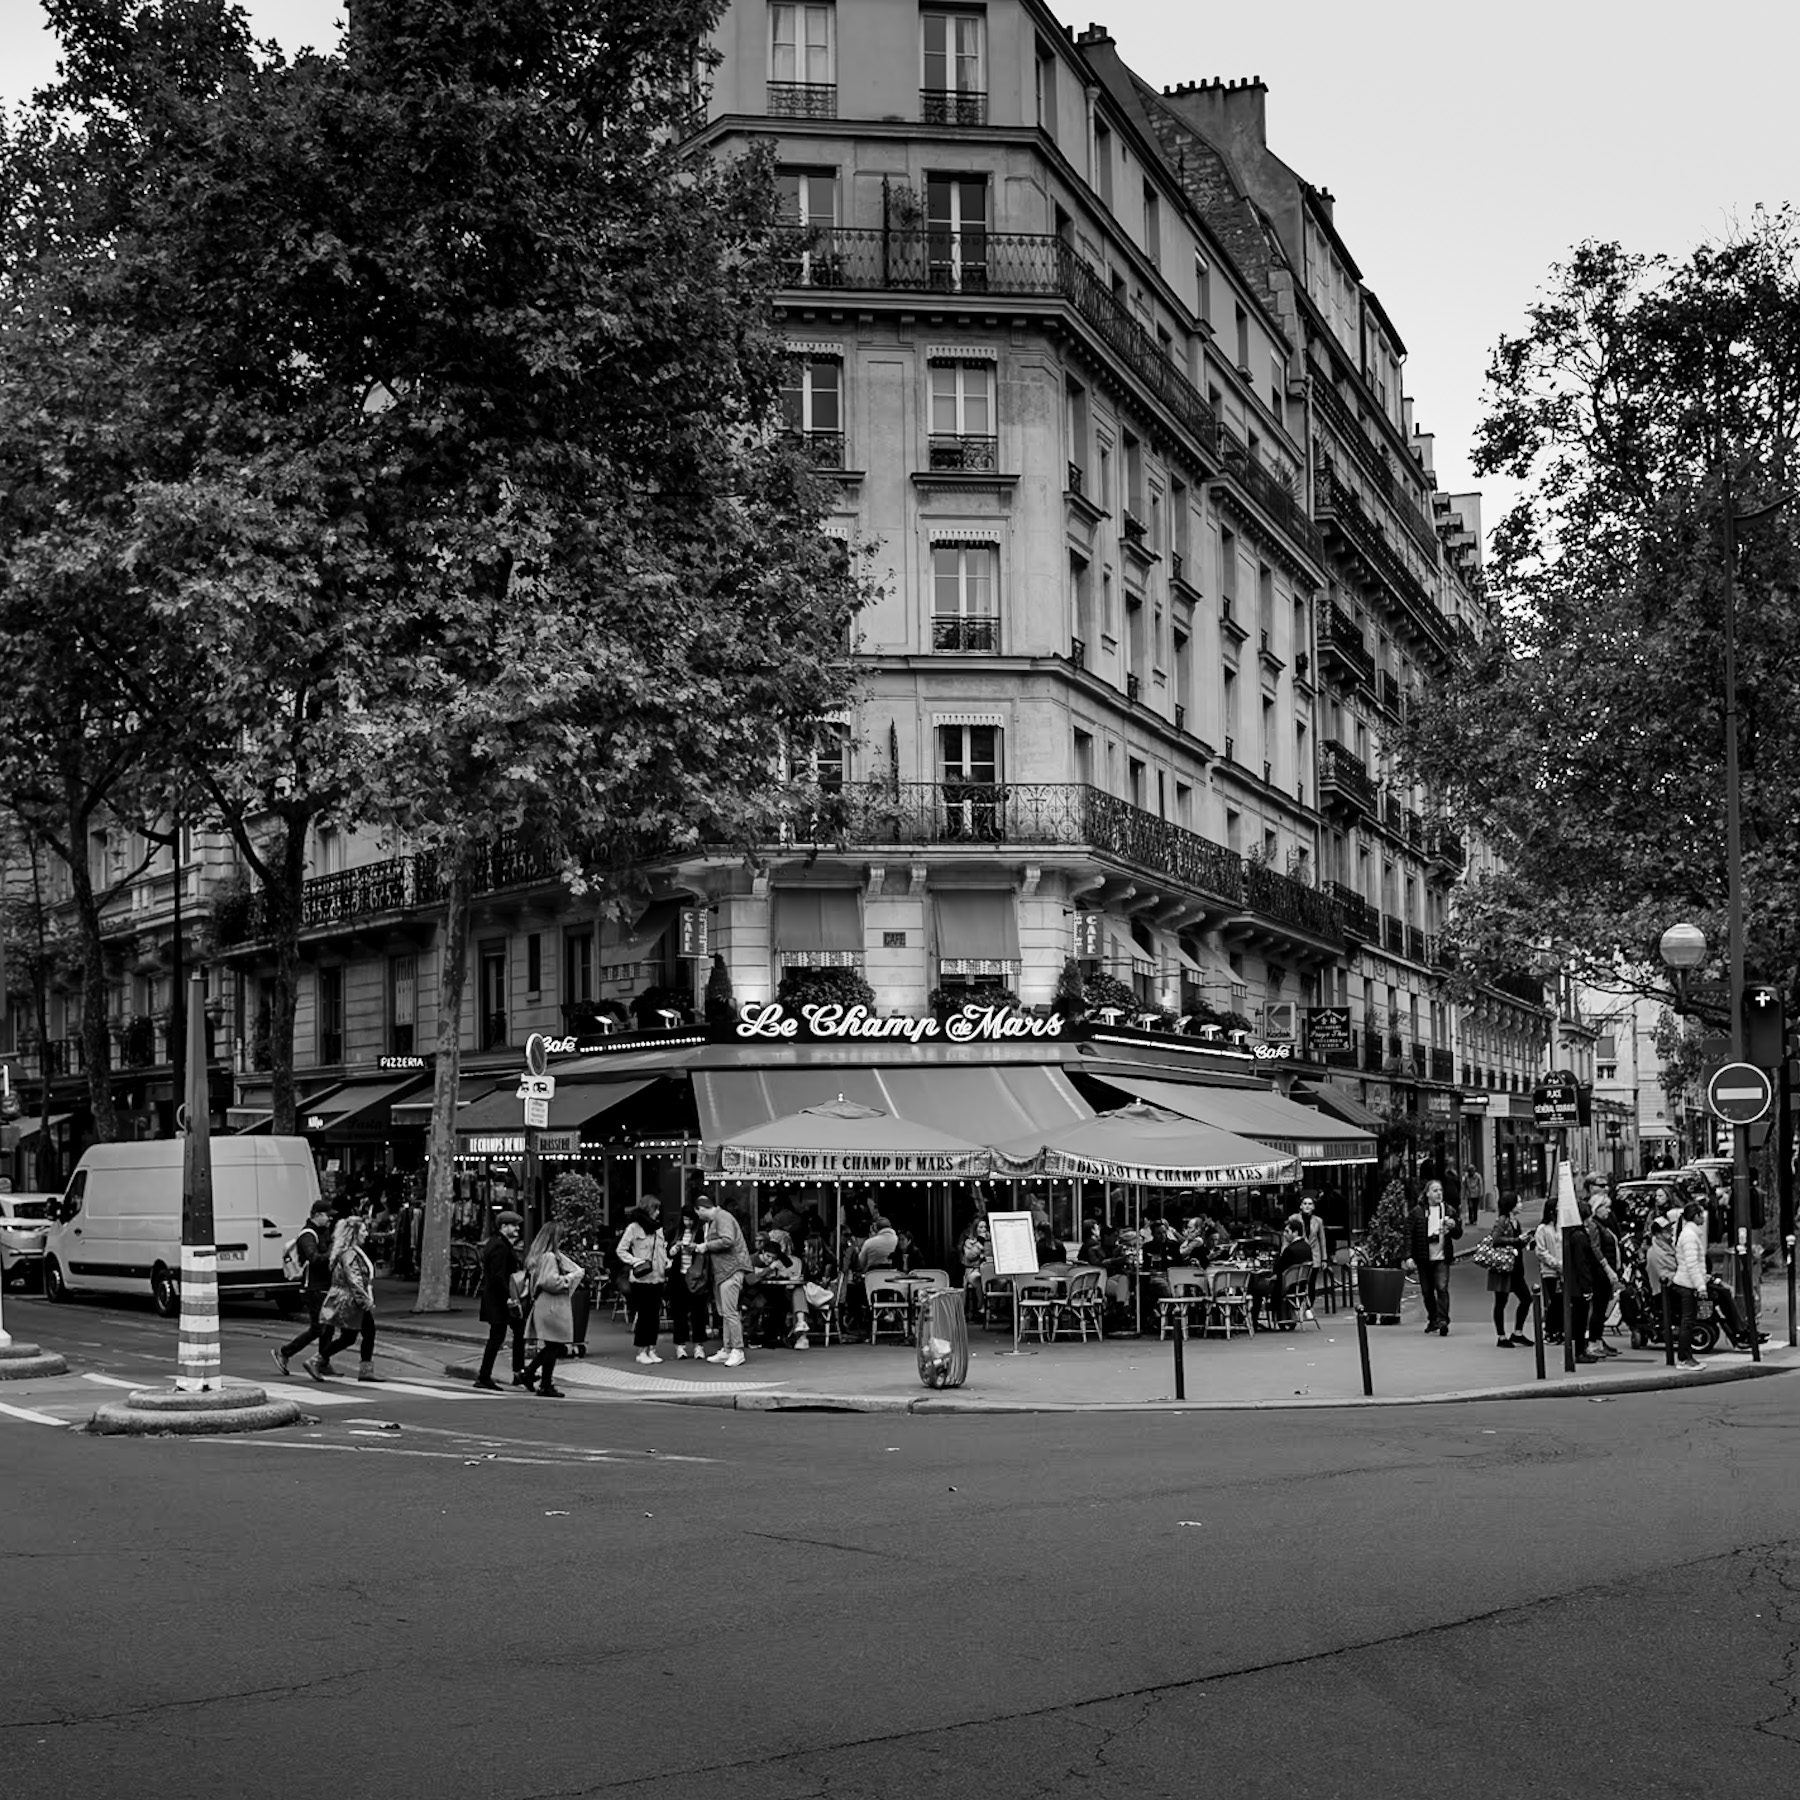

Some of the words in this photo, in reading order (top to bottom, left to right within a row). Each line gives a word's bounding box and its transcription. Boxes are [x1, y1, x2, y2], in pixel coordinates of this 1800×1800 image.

[736, 1003, 798, 1038] Le
[801, 1003, 941, 1042] Champ
[950, 1003, 1065, 1041] Mars
[950, 1017, 973, 1037] de
[380, 1057, 424, 1068] PIZZERIA
[759, 1153, 817, 1169] BISTROT
[823, 1154, 838, 1170] LE
[842, 1155, 891, 1170] CHAMP
[895, 1156, 912, 1171] DE
[916, 1156, 954, 1171] MARS
[1077, 1160, 1131, 1179] BISTROT
[1136, 1168, 1150, 1180] LE
[1155, 1169, 1201, 1181] CHAMP
[1205, 1169, 1222, 1181] DE
[1225, 1167, 1263, 1181] MARS
